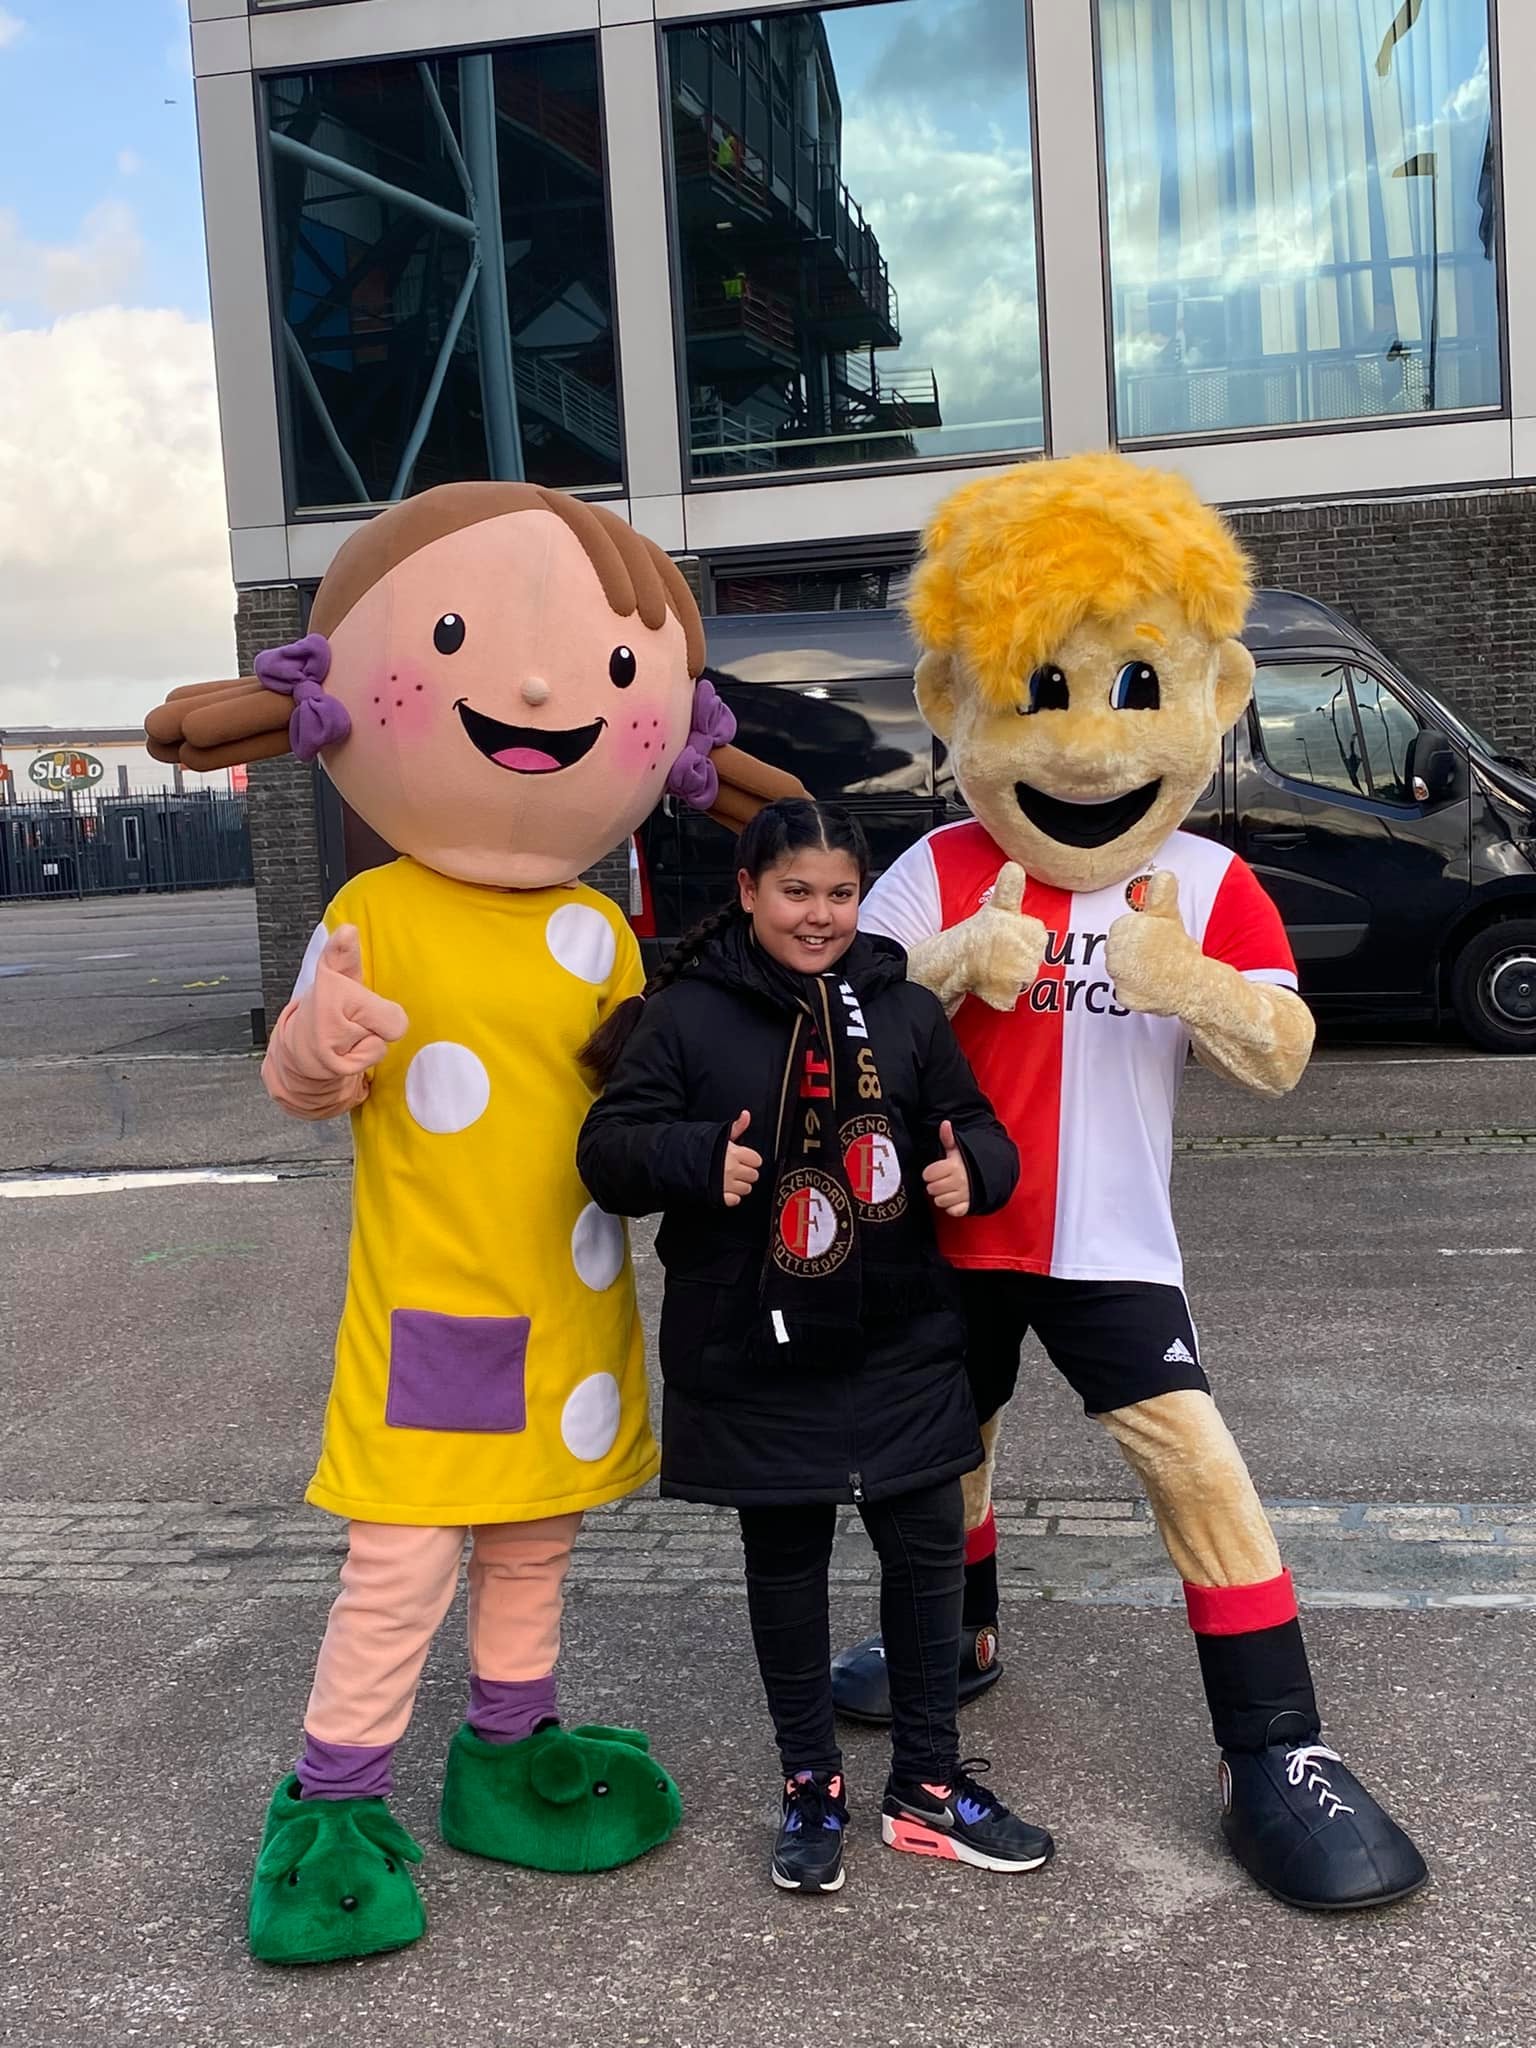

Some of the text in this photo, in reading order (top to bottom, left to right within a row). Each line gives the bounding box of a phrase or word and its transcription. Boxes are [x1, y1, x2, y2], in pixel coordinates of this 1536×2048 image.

[33, 761, 101, 782] Sligo
[1044, 932, 1107, 965] ur
[1020, 977, 1131, 1017] arcs
